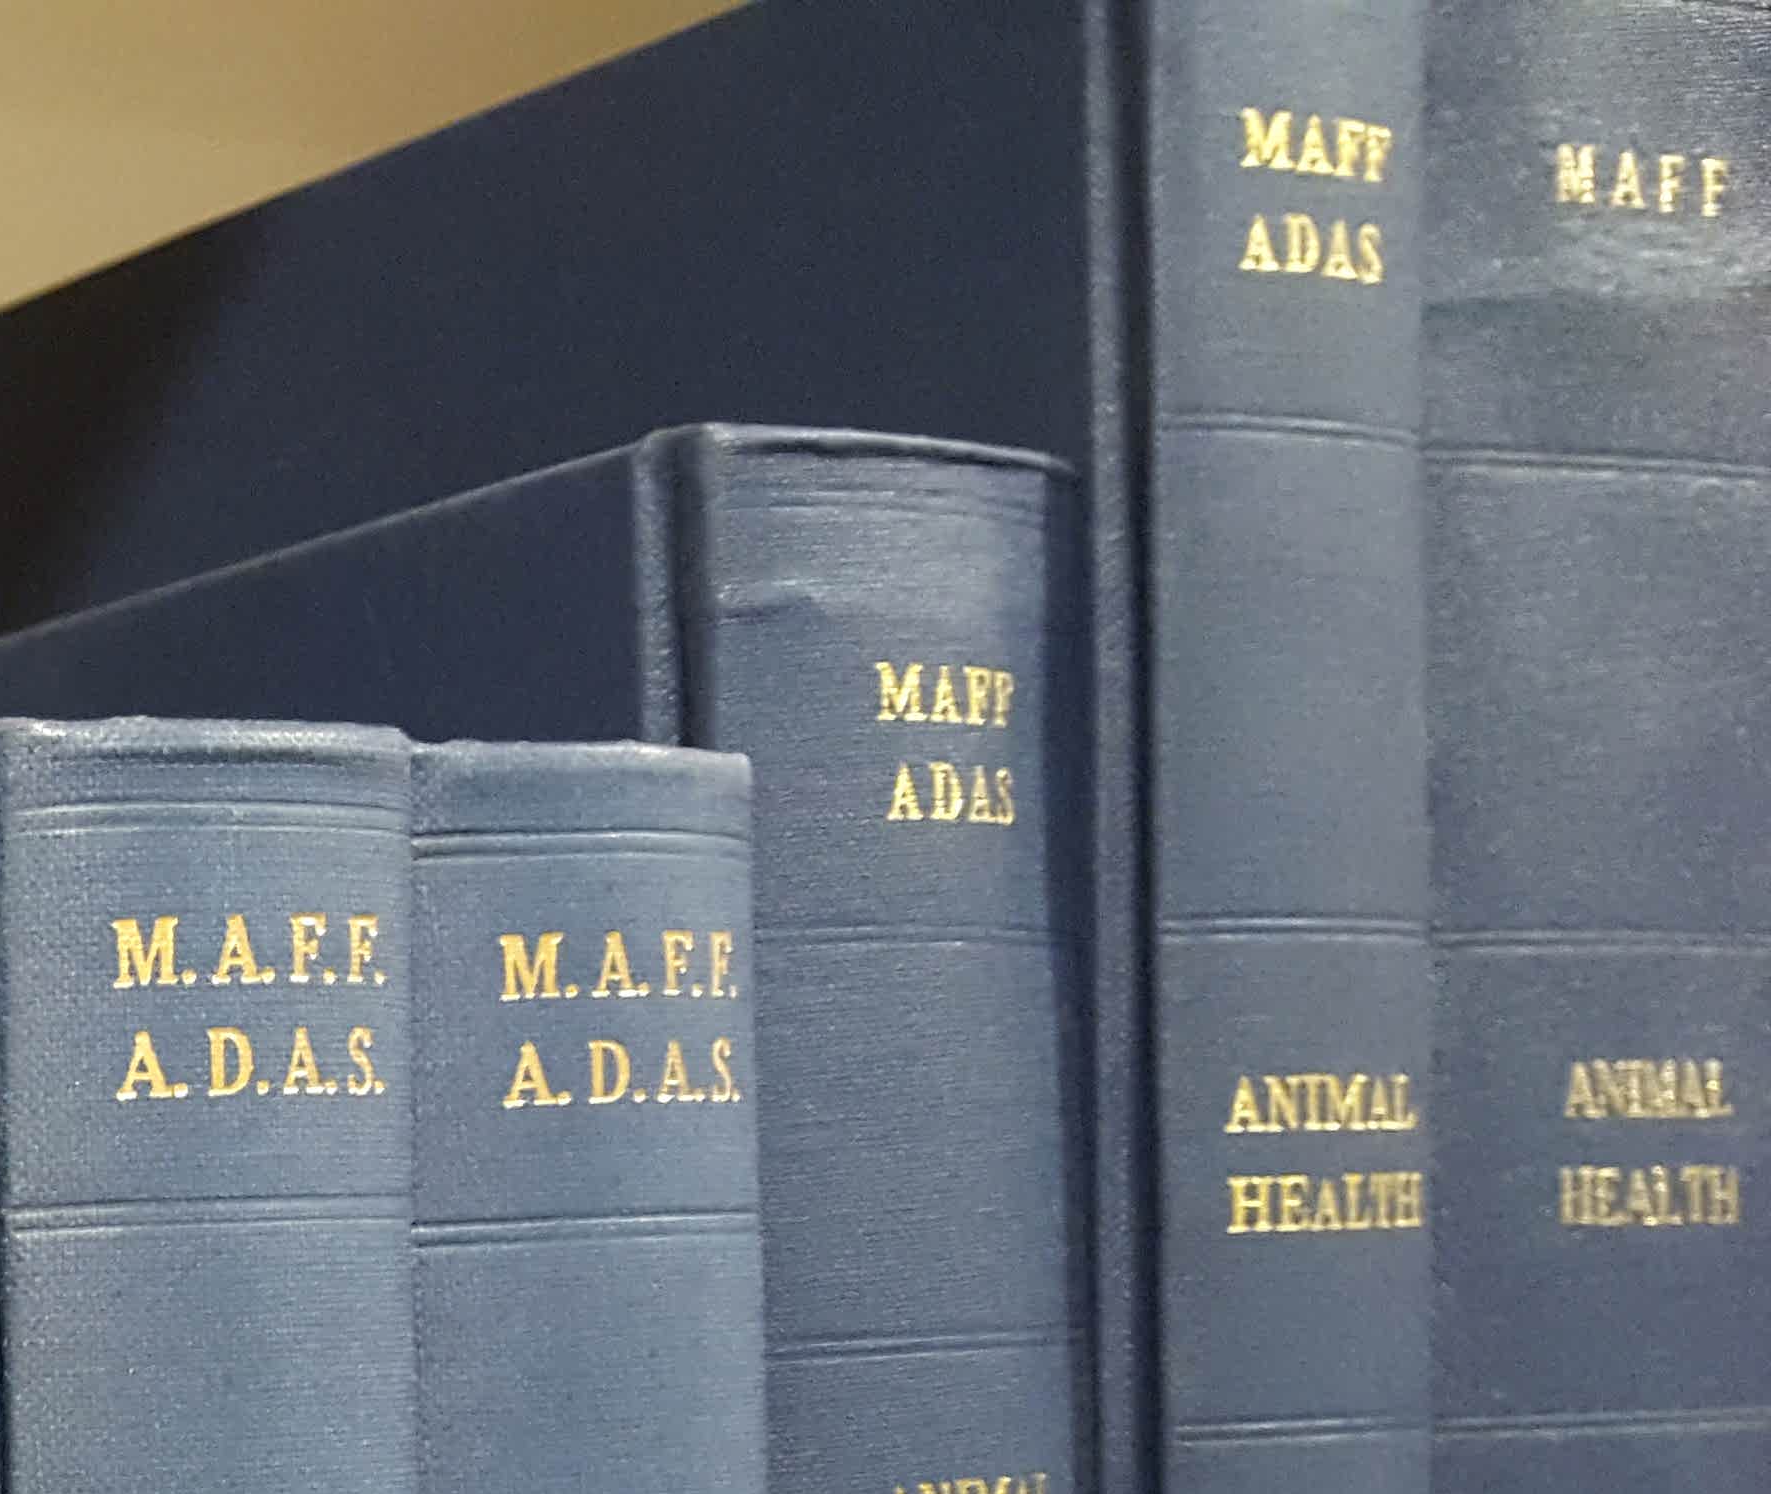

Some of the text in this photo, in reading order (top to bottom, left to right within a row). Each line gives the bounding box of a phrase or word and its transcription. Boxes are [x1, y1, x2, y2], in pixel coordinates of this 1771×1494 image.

[1237, 105, 1393, 183] MAFF
[1237, 211, 1384, 286] ADAS
[885, 759, 1017, 827] ADAS
[109, 910, 386, 990] M.A.F.F.
[496, 928, 739, 1003] M.A.F.F.
[115, 1025, 386, 1103] A.D.A.S.
[501, 1035, 742, 1111] A.D.A.S.
[1563, 1057, 1735, 1120] ANIMAL
[1222, 1071, 1421, 1134] ANIMAL
[1225, 1170, 1424, 1236] HEALTH
[1559, 1163, 1741, 1228] HEALTH
